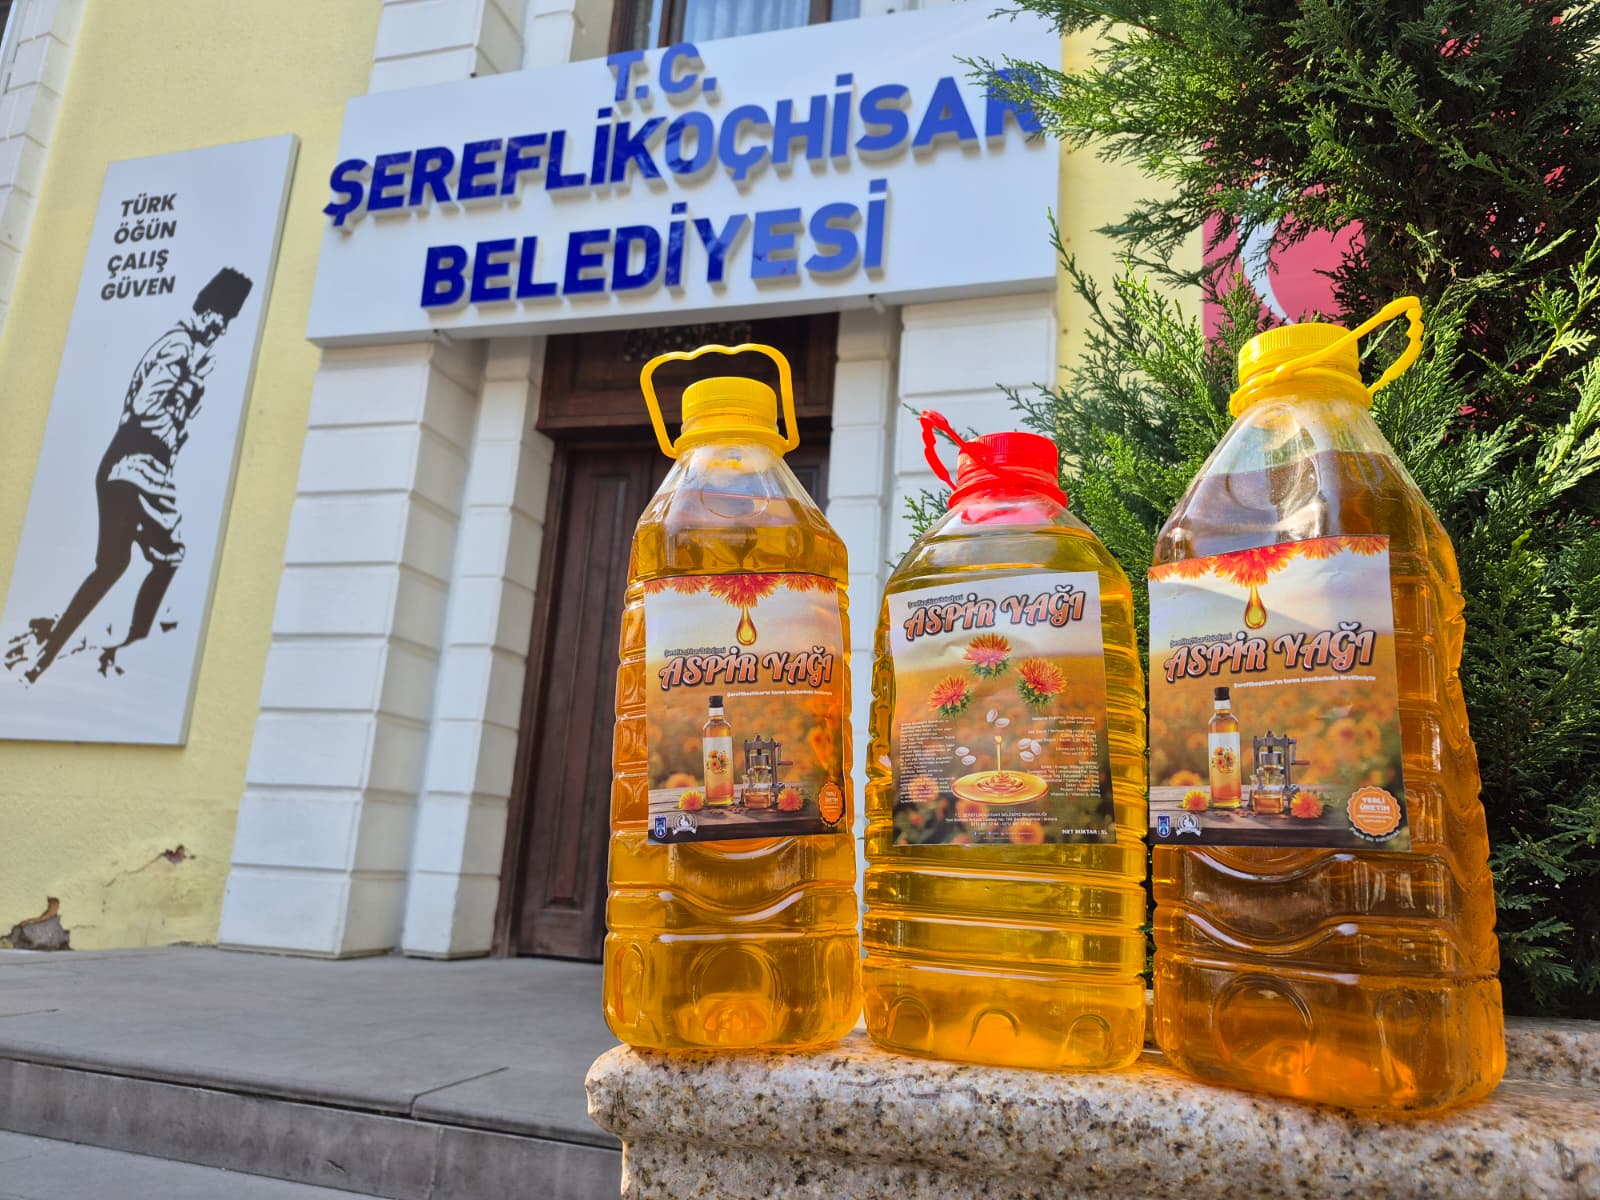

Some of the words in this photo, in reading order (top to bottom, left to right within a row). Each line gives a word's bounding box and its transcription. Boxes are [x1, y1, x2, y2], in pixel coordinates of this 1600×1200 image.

[121, 193, 177, 217] TÜRK
[113, 218, 177, 244] ÖĞÜN
[420, 178, 889, 308] BELEDİYESİ
[107, 249, 170, 279] ÇALIŞ
[101, 276, 176, 301] GÜVEN
[904, 593, 996, 641] ASPİR
[1000, 584, 1086, 627] YAĞI
[658, 646, 758, 691] ASPİR
[762, 646, 834, 687] YAĞI
[1163, 630, 1267, 683] ASPİR
[1273, 621, 1377, 672] YAĞI
